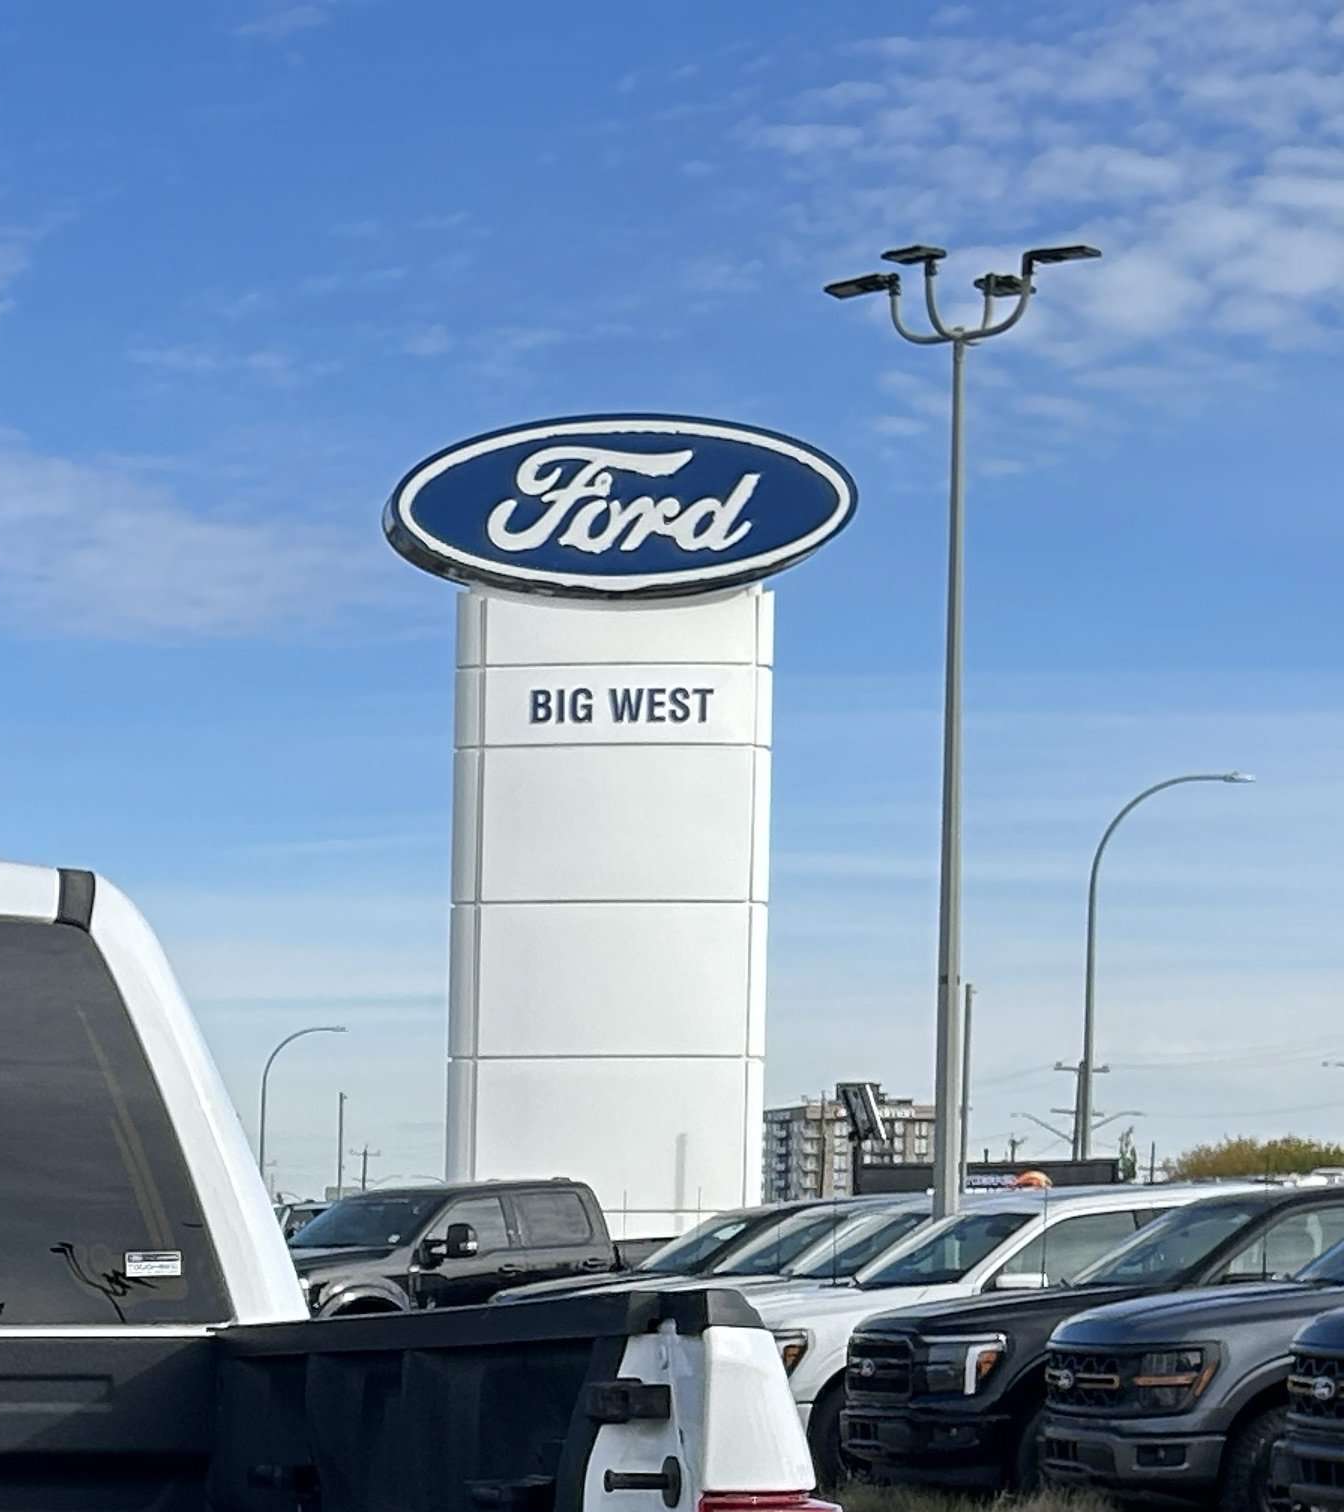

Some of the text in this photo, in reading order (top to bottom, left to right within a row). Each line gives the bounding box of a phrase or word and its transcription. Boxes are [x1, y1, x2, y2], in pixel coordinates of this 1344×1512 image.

[486, 445, 761, 554] Ford
[529, 687, 715, 725] BIG WEST
